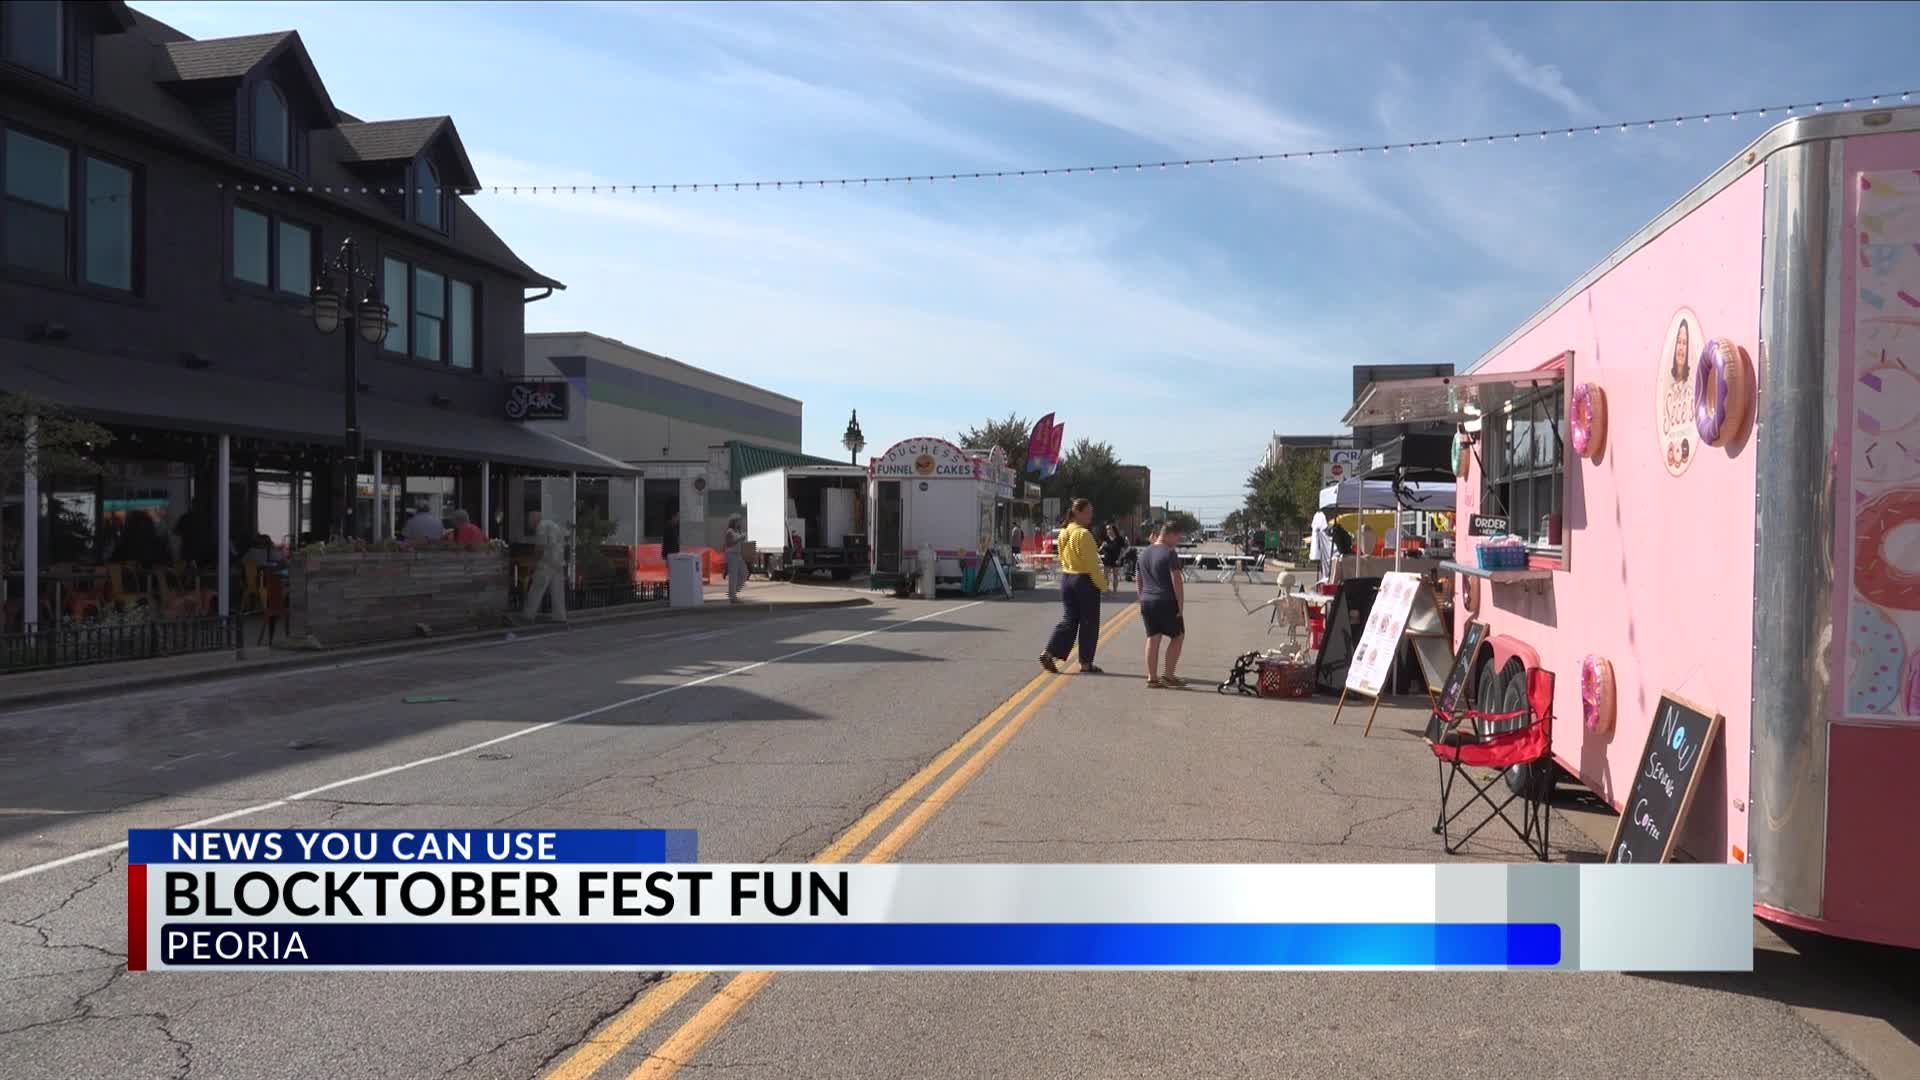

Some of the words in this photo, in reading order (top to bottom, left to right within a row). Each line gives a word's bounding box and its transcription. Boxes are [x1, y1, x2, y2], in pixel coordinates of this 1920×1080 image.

[888, 444, 960, 464] DUCHESS
[877, 464, 913, 475] FUNNEL
[936, 464, 971, 475] CAKES
[1475, 517, 1507, 530] ORDER
[1661, 705, 1697, 771] NOW
